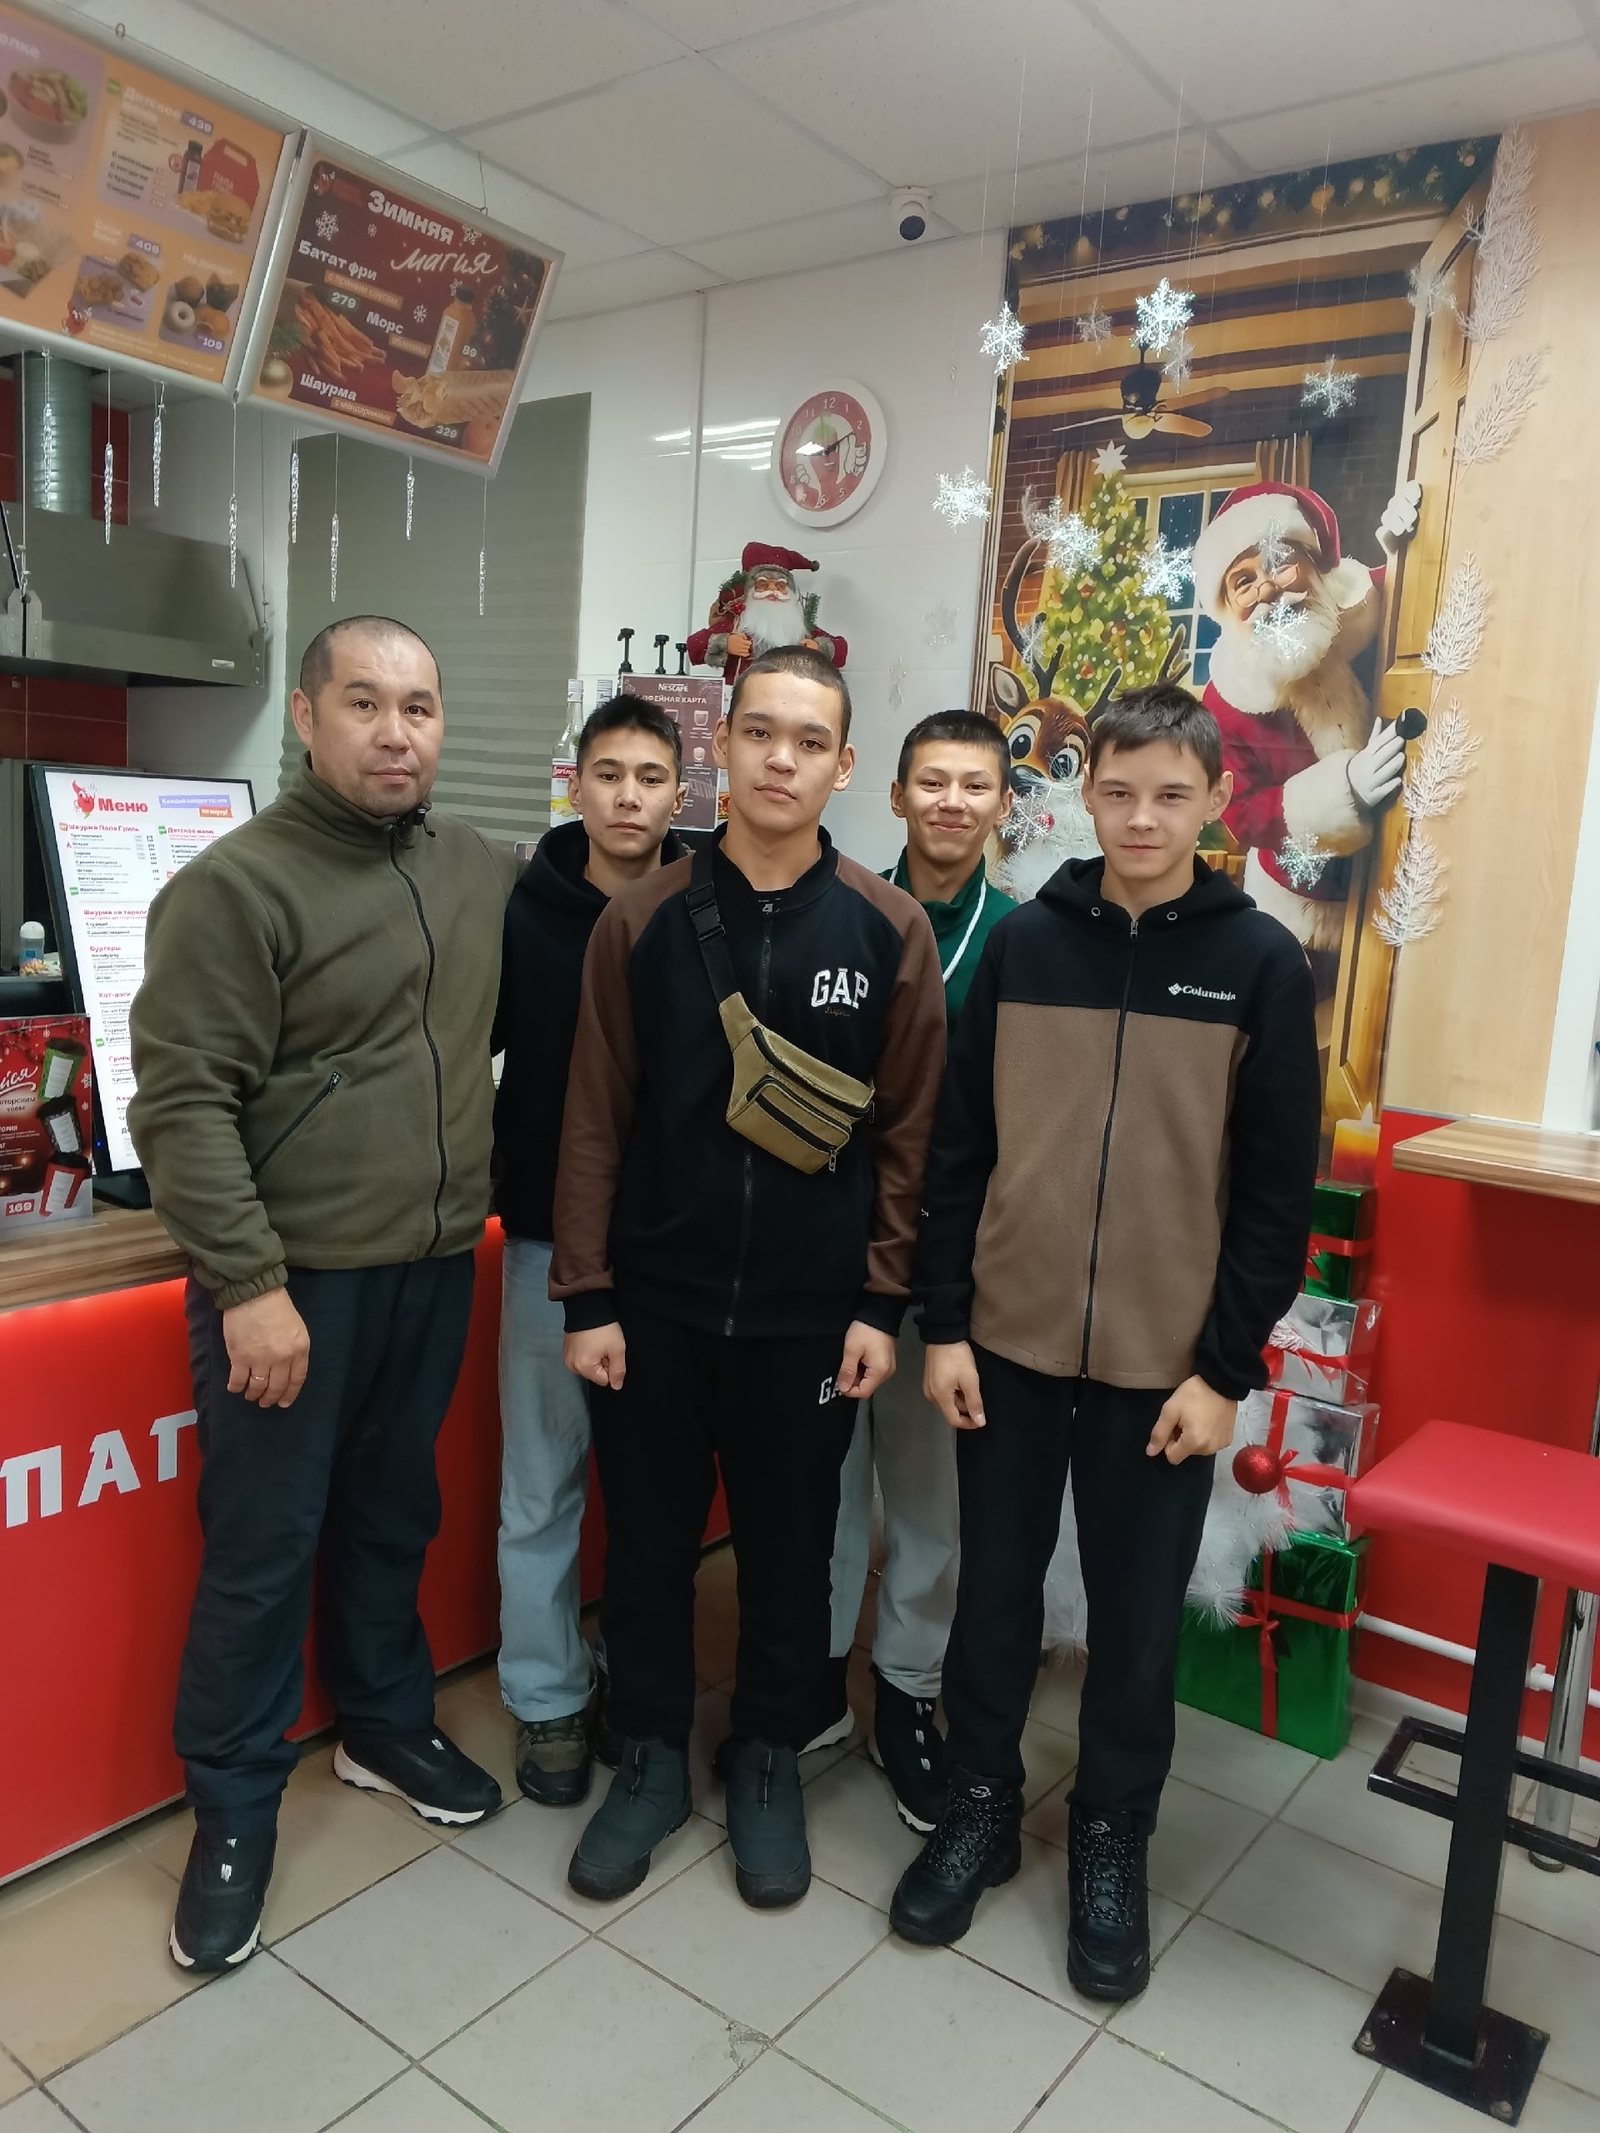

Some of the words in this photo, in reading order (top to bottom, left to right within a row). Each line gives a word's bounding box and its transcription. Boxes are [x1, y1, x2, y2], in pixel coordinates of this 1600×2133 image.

[367, 190, 455, 245] Зимняя
[135, 240, 160, 254] 409
[298, 239, 347, 268] Батат
[348, 261, 378, 281] фри
[391, 248, 498, 274] магия
[331, 292, 357, 309] 279
[366, 311, 404, 334] Морс
[203, 337, 223, 350] 109
[462, 345, 478, 357] 89
[300, 373, 357, 402] Шаурма
[435, 425, 458, 439] 329
[682, 696, 707, 704] КАРТА
[98, 798, 149, 813] Меню
[811, 967, 869, 1010] GAP
[1182, 985, 1236, 1001] Columbia
[8, 1201, 32, 1214] 169
